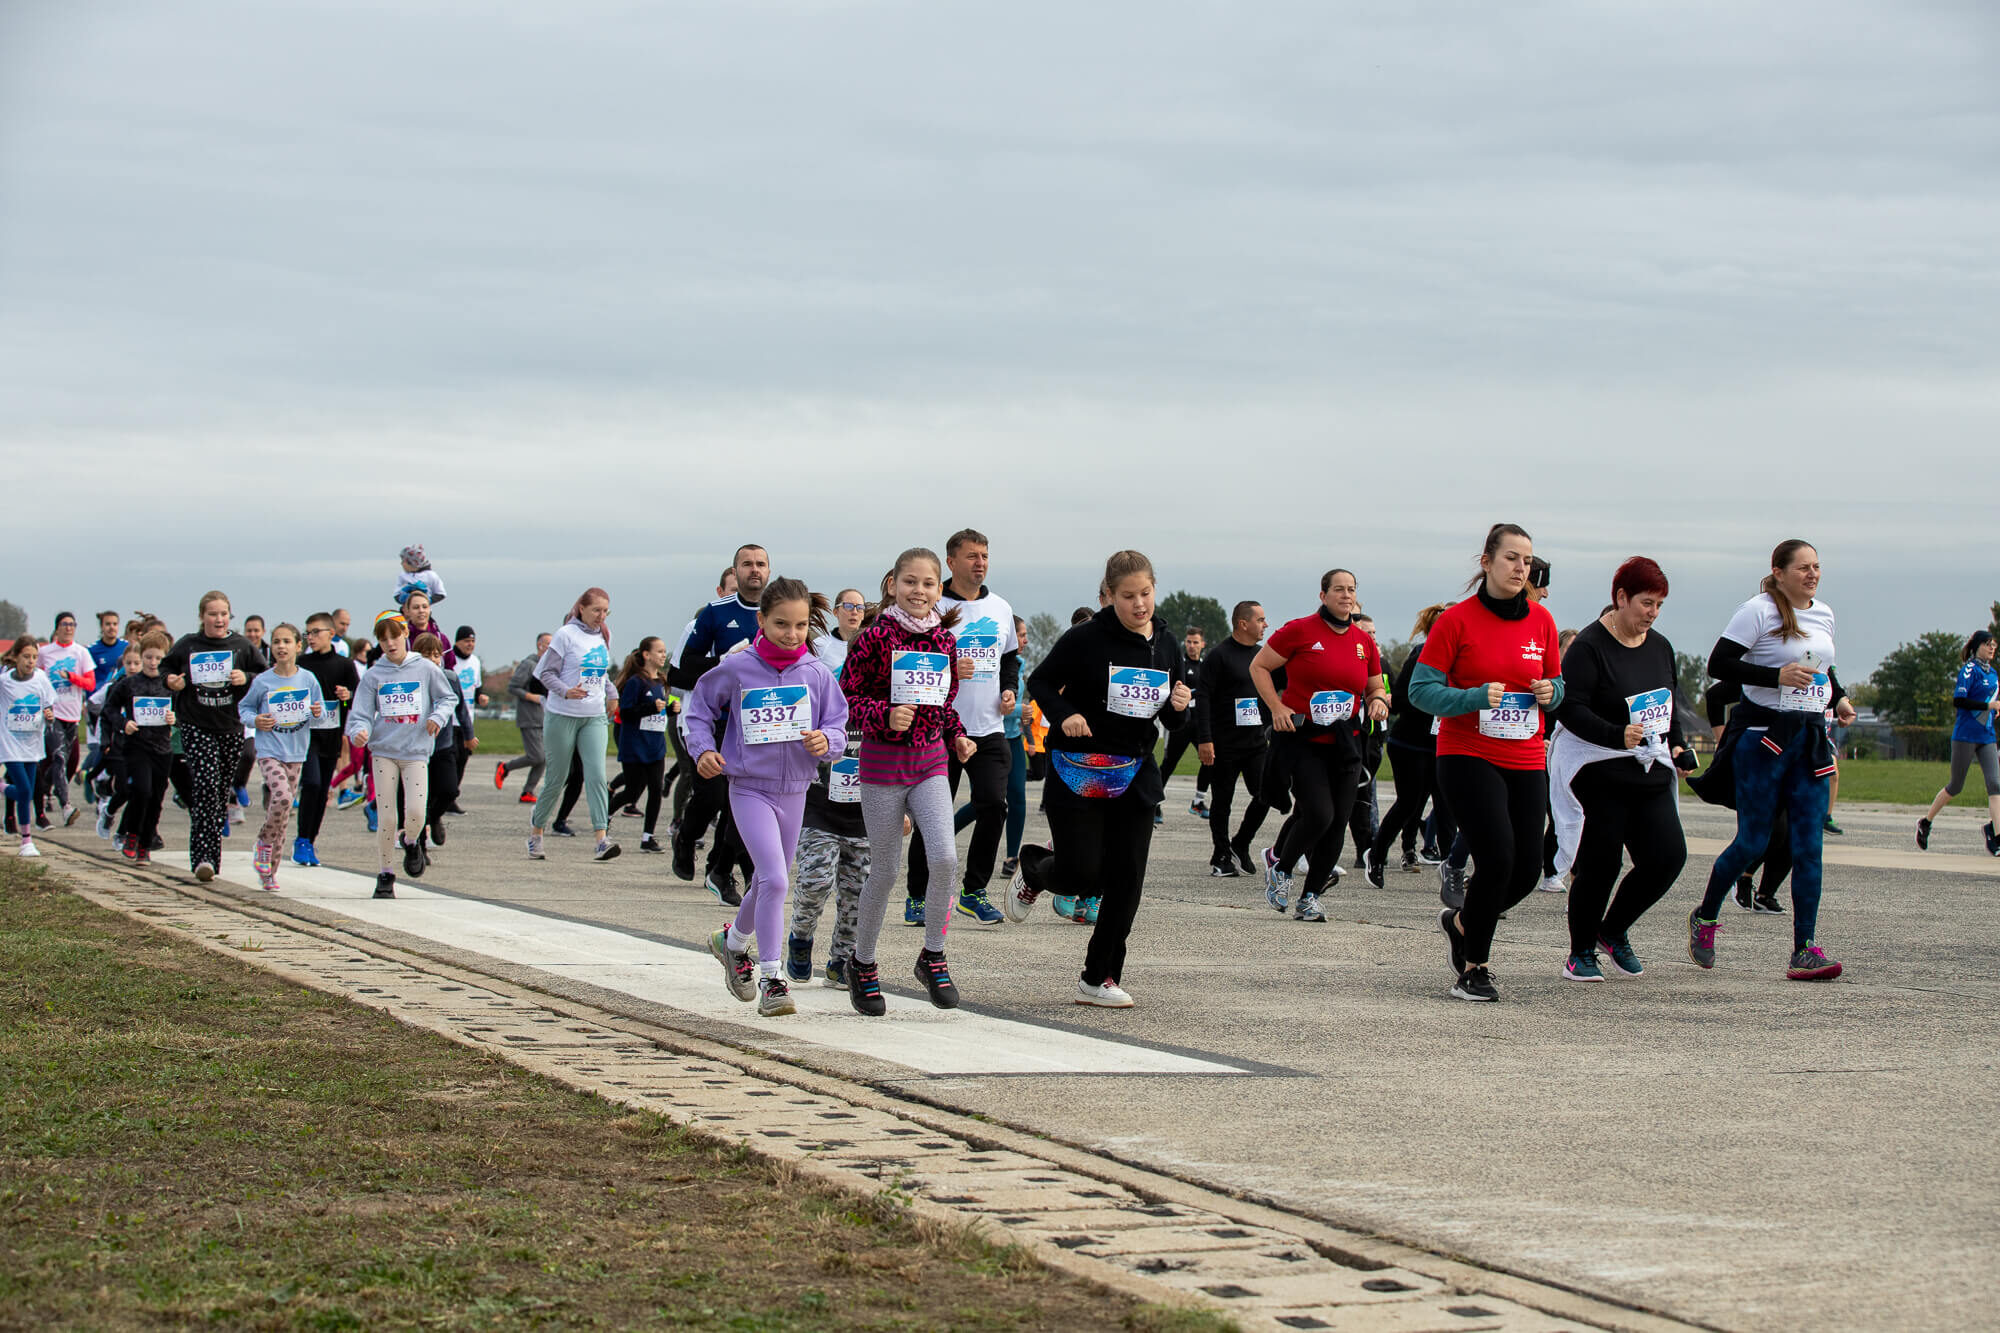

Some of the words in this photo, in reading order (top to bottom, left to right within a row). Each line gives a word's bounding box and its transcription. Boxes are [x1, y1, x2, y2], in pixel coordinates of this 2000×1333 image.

[957, 649, 996, 658] 3555/3
[198, 663, 225, 672] 3305
[905, 671, 943, 686] 3357
[385, 693, 414, 704] 3296
[1120, 685, 1160, 701] 3338
[140, 707, 165, 716] 3308
[276, 702, 305, 712] 3306
[1243, 708, 1257, 716] 290
[1313, 703, 1352, 713] 2619/2
[750, 706, 797, 723] 3337
[1491, 709, 1530, 722] 2837
[1640, 705, 1668, 722] 2922
[841, 775, 860, 786] 32
